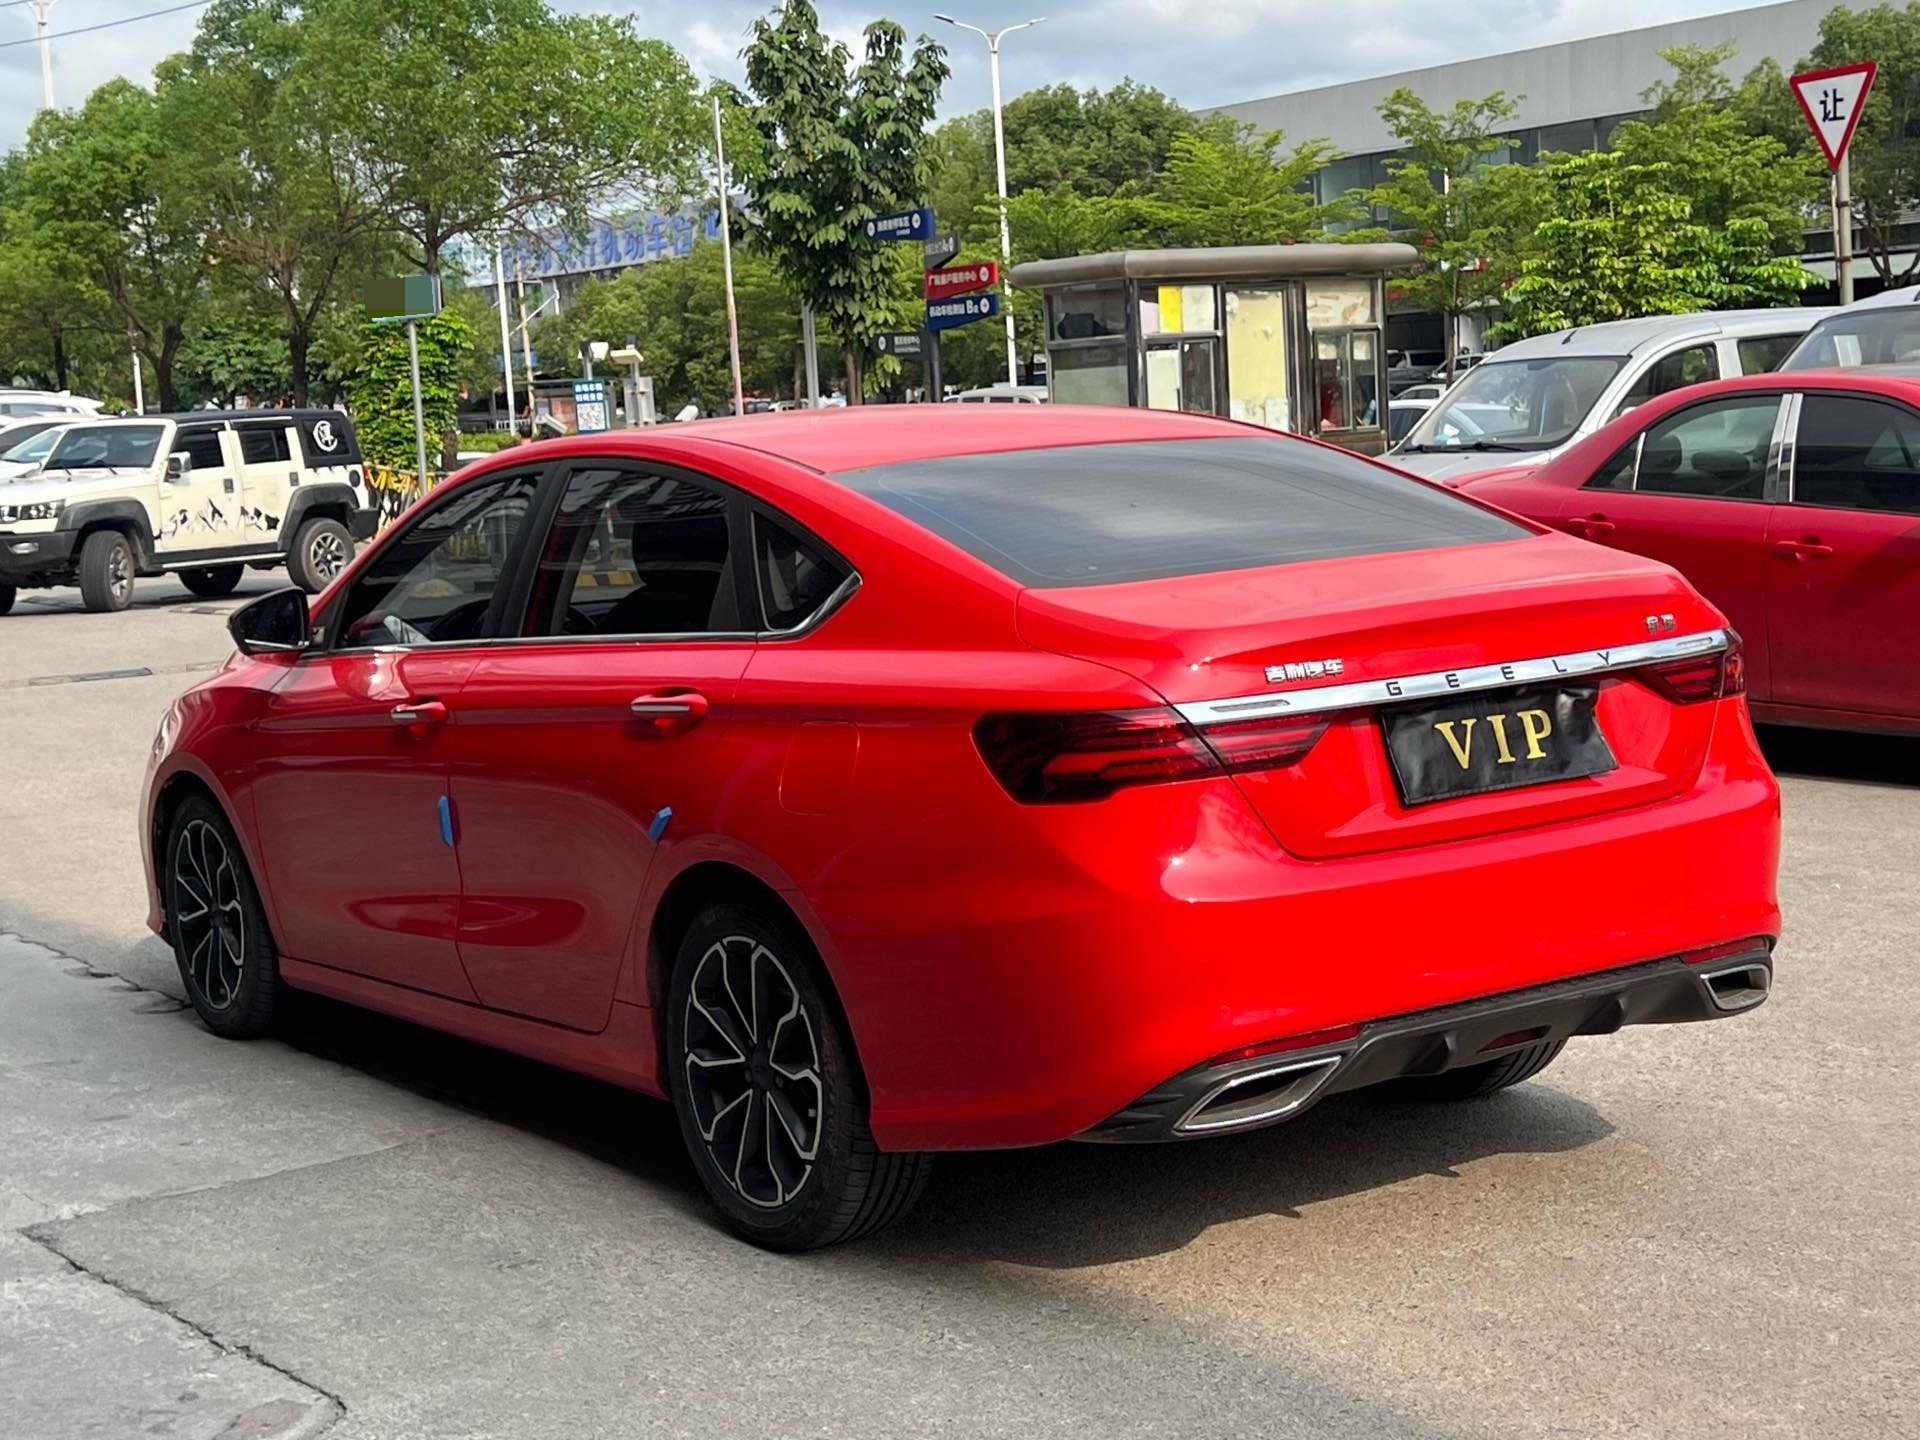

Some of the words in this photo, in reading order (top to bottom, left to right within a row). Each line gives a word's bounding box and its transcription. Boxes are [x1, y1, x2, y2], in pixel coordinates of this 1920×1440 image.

[1819, 88, 1845, 122] 让
[1264, 659, 1345, 684] 吉利汽车
[1386, 651, 1610, 696] GEELY
[1434, 709, 1551, 769] VIP
